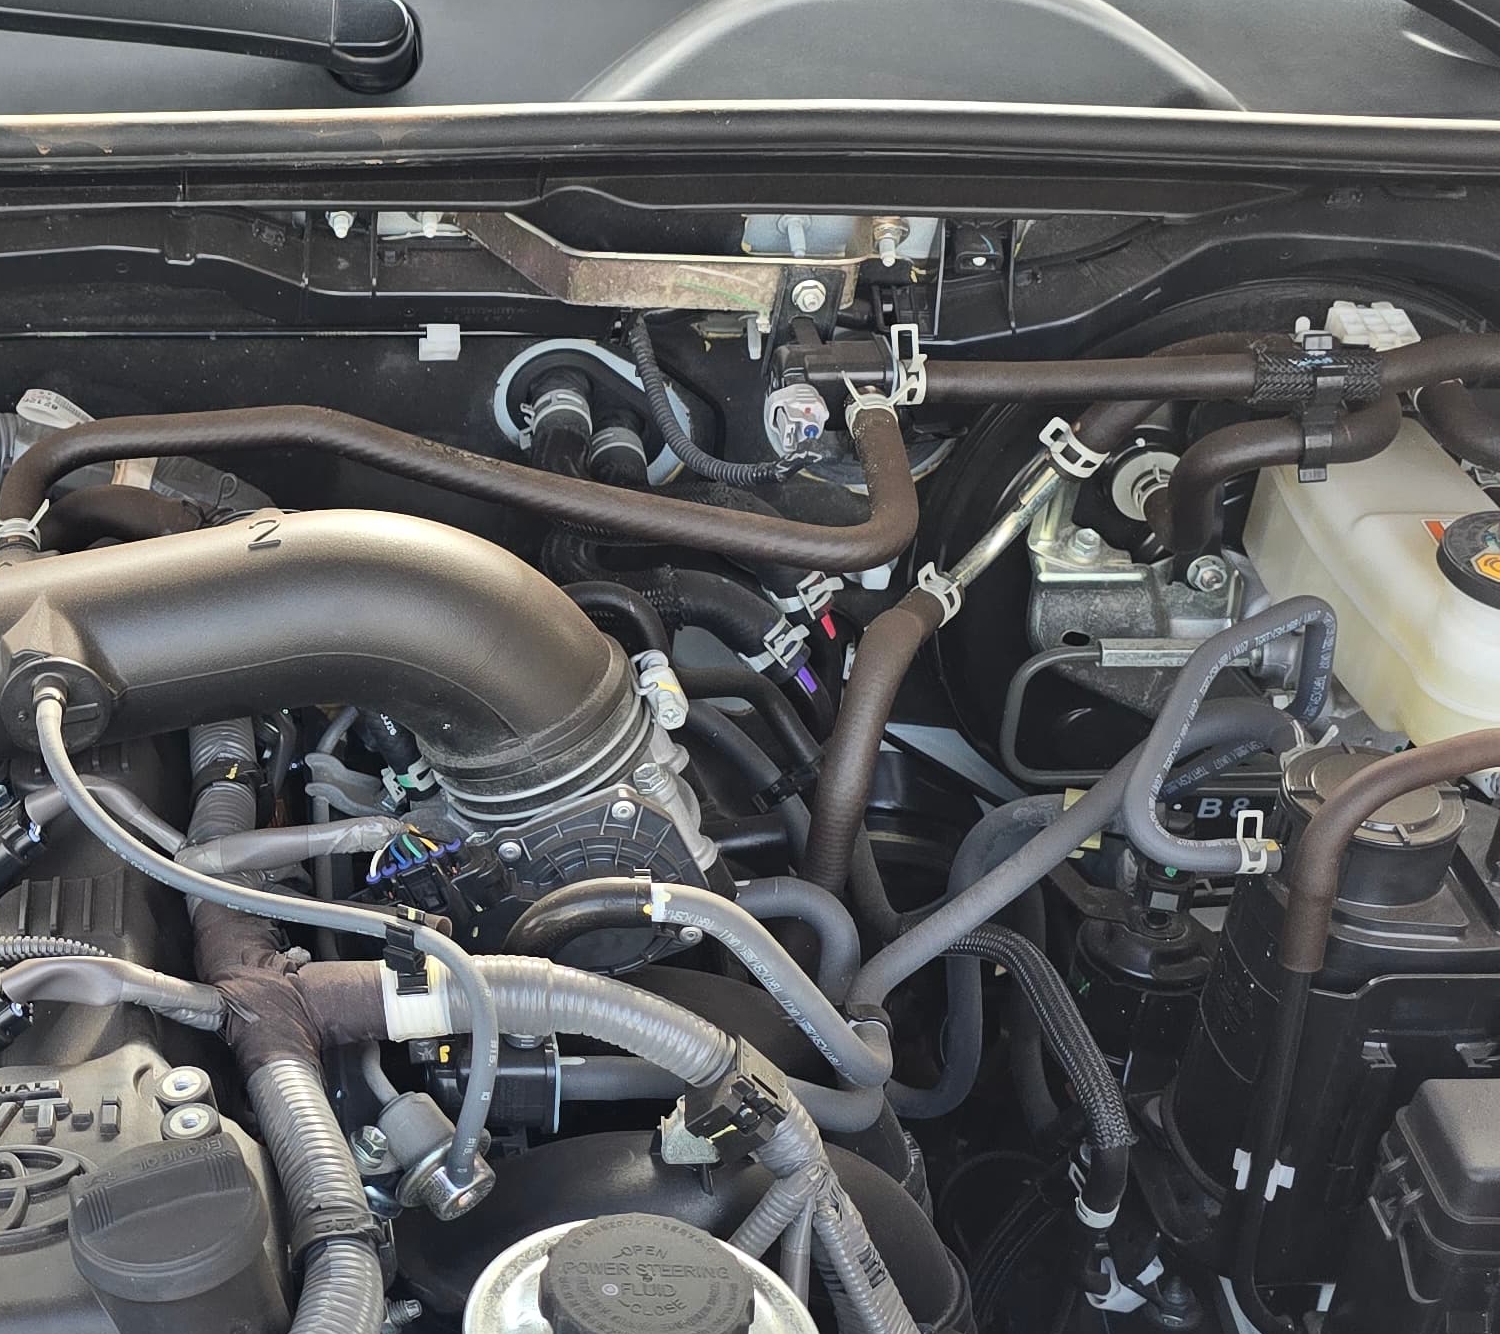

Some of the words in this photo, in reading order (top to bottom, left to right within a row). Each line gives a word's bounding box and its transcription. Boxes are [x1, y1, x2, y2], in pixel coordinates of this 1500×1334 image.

[248, 519, 281, 550] 2
[1197, 798, 1223, 819] B
[620, 1244, 669, 1260] OPEN
[563, 1261, 631, 1276] POWER
[635, 1262, 730, 1280] STEERING
[620, 1282, 677, 1298] FLUID
[629, 1297, 688, 1318] CLOSE
